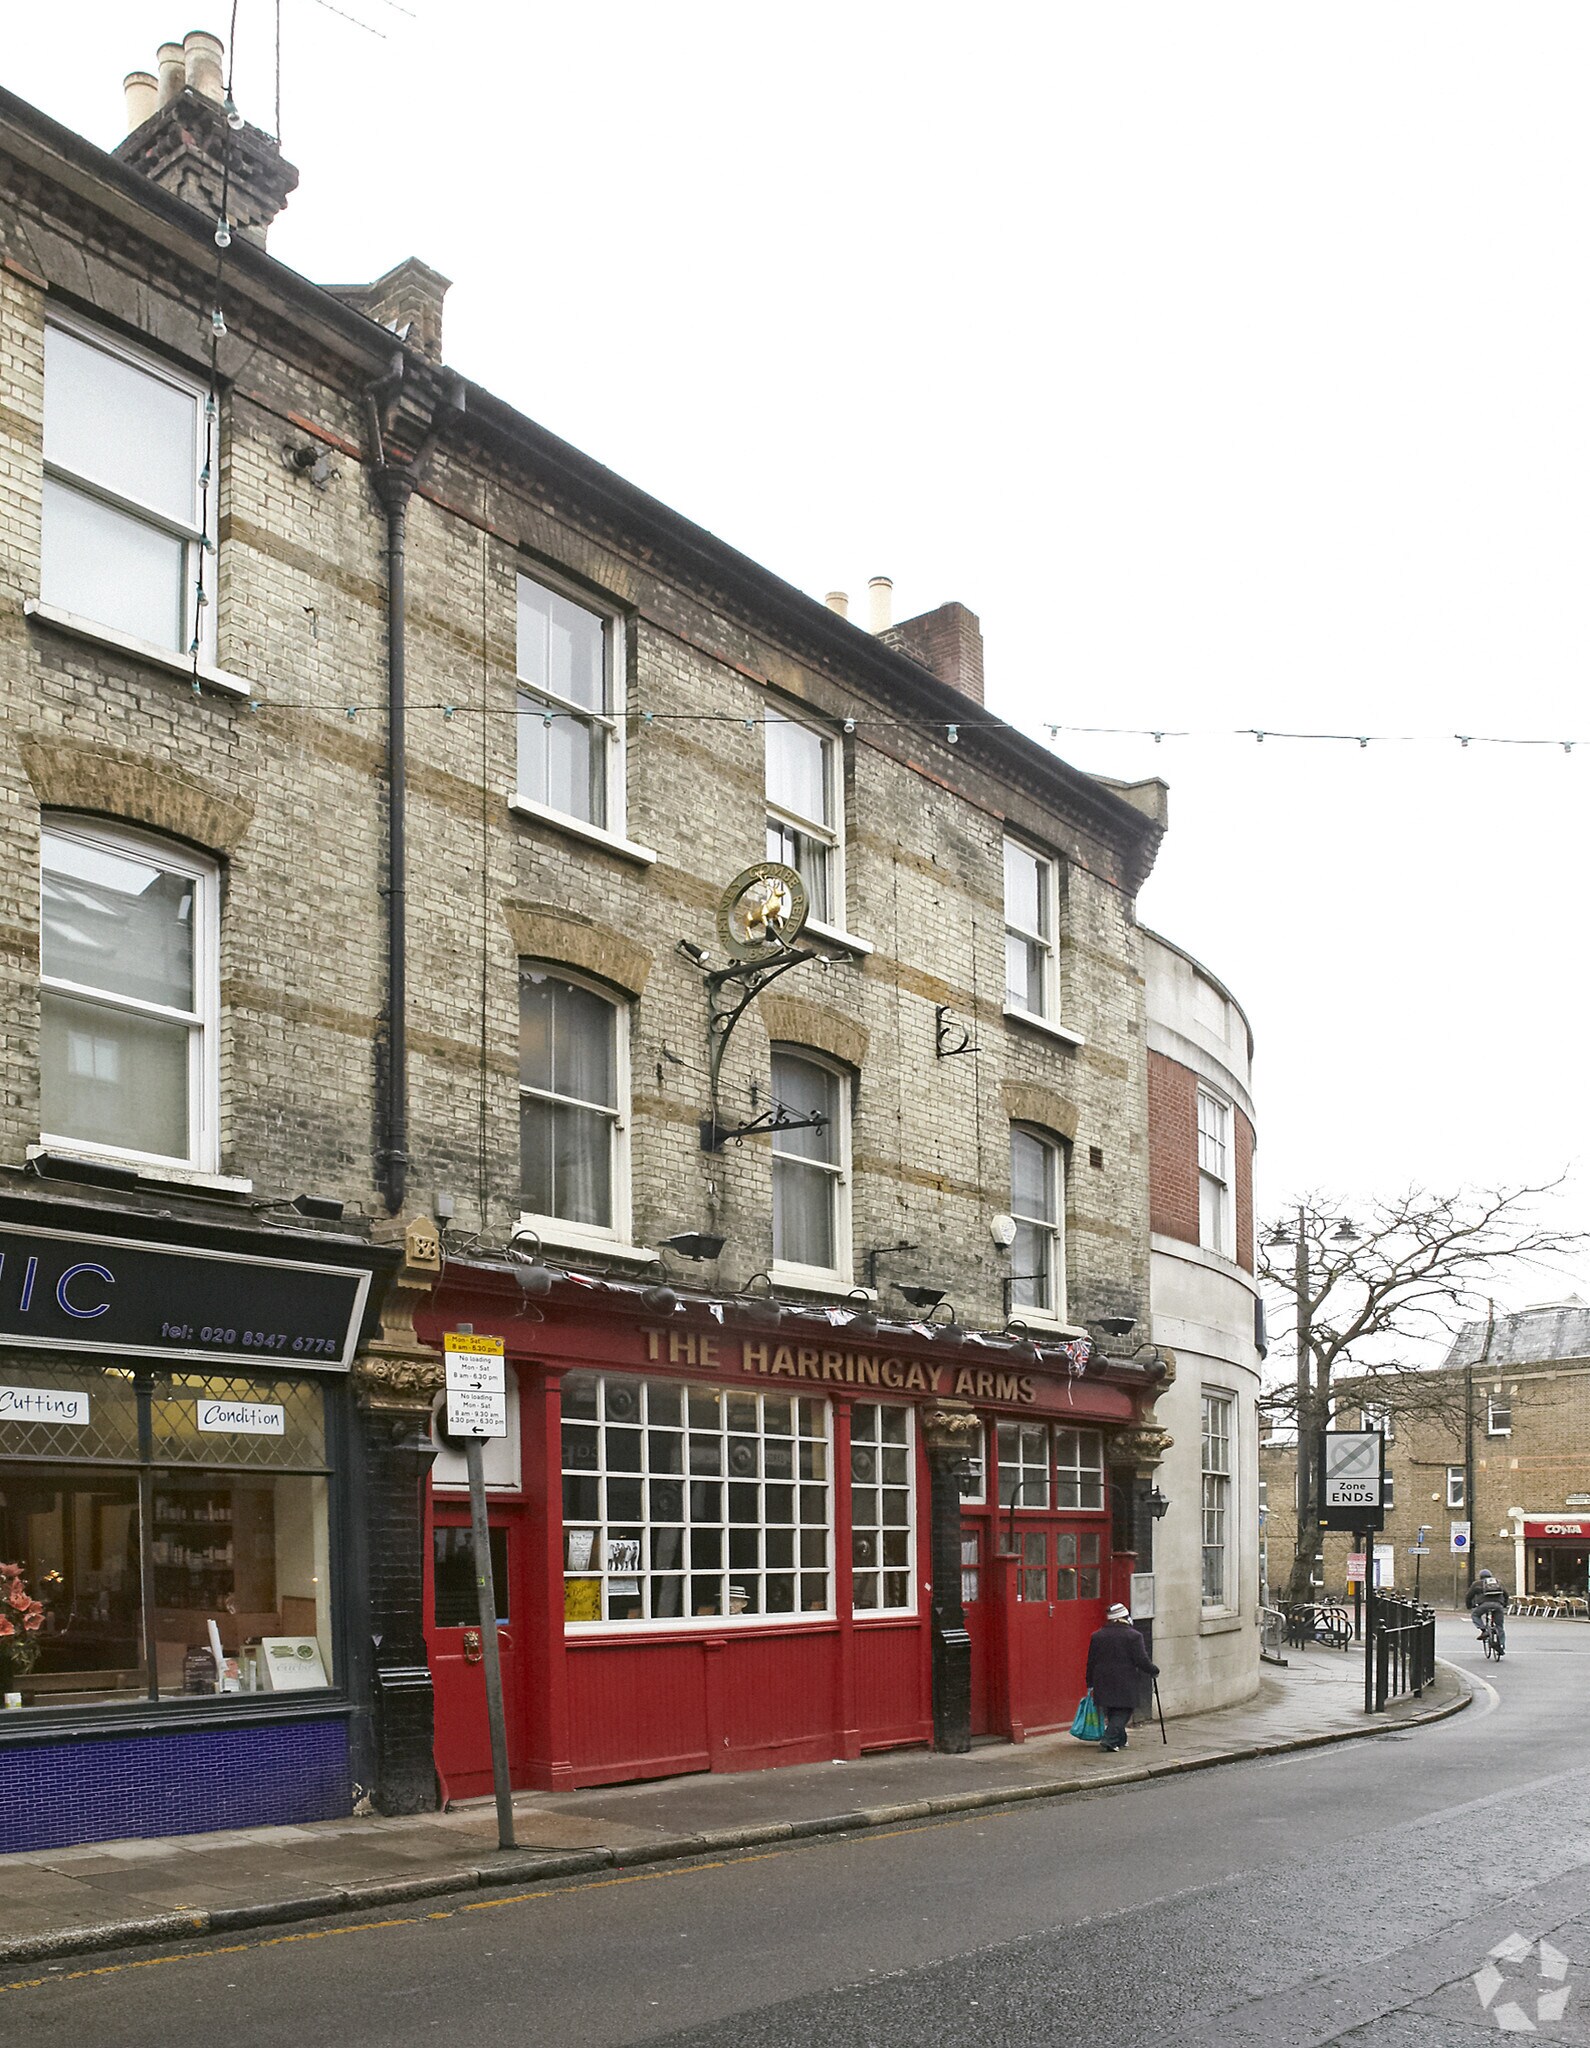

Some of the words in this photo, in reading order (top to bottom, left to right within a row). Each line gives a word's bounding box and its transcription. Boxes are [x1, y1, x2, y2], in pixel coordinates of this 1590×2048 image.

[749, 863, 800, 890] COMBE
[786, 895, 804, 934] REID
[0, 1253, 116, 1319] IC
[160, 1322, 194, 1340] tel:
[200, 1326, 238, 1345] 020
[242, 1331, 287, 1350] 8347
[292, 1336, 337, 1355] 6775
[640, 1325, 721, 1368] THE
[742, 1339, 944, 1393] HARRINGAY
[954, 1366, 1039, 1406] ARMS
[0, 1391, 78, 1418] Cutting
[204, 1404, 280, 1427] Condition
[1332, 1492, 1374, 1502] ENDS
[1340, 1482, 1366, 1490] Zone
[1544, 1524, 1582, 1535] COSTA
